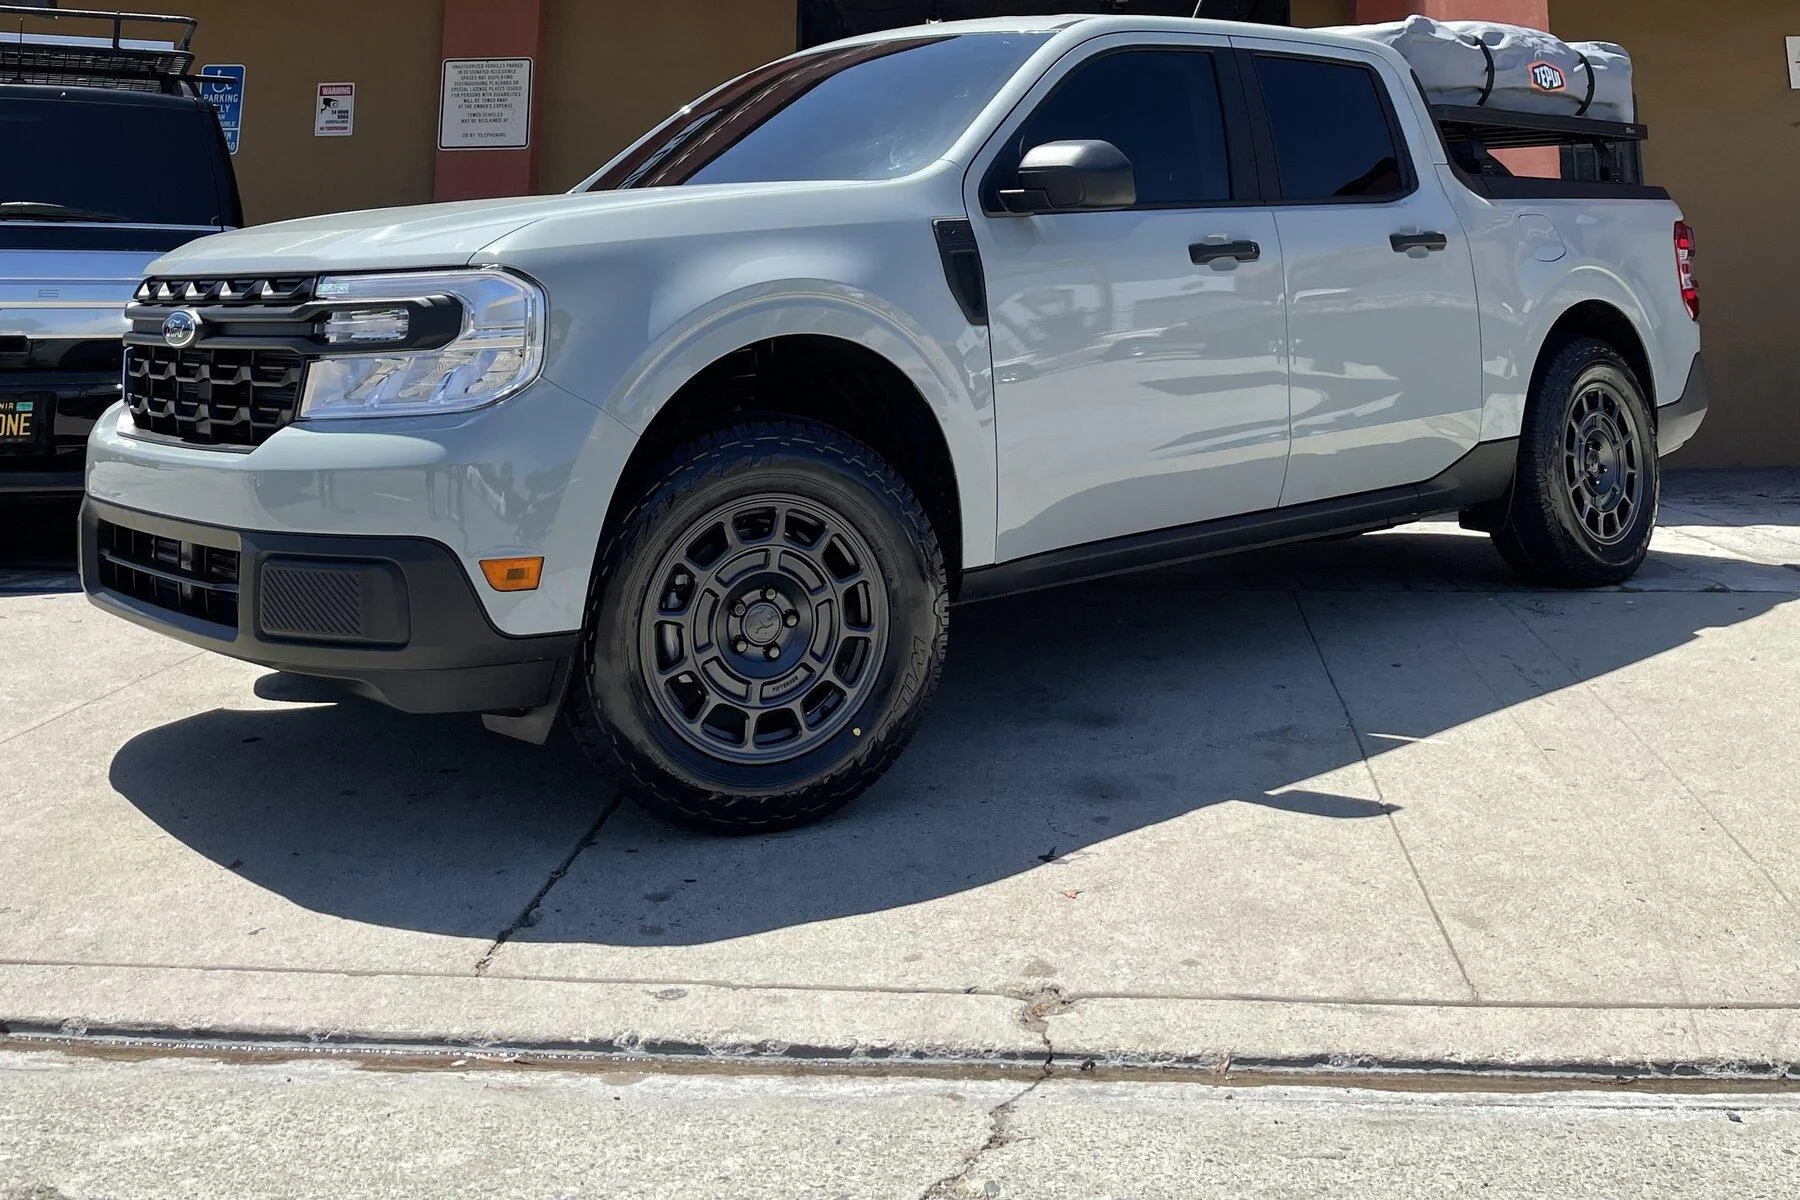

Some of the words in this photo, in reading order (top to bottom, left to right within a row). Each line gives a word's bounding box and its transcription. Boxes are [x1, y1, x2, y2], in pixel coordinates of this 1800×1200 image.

[1533, 65, 1562, 89] TEPUI
[321, 86, 351, 95] WARNING
[203, 93, 239, 103] PARKING
